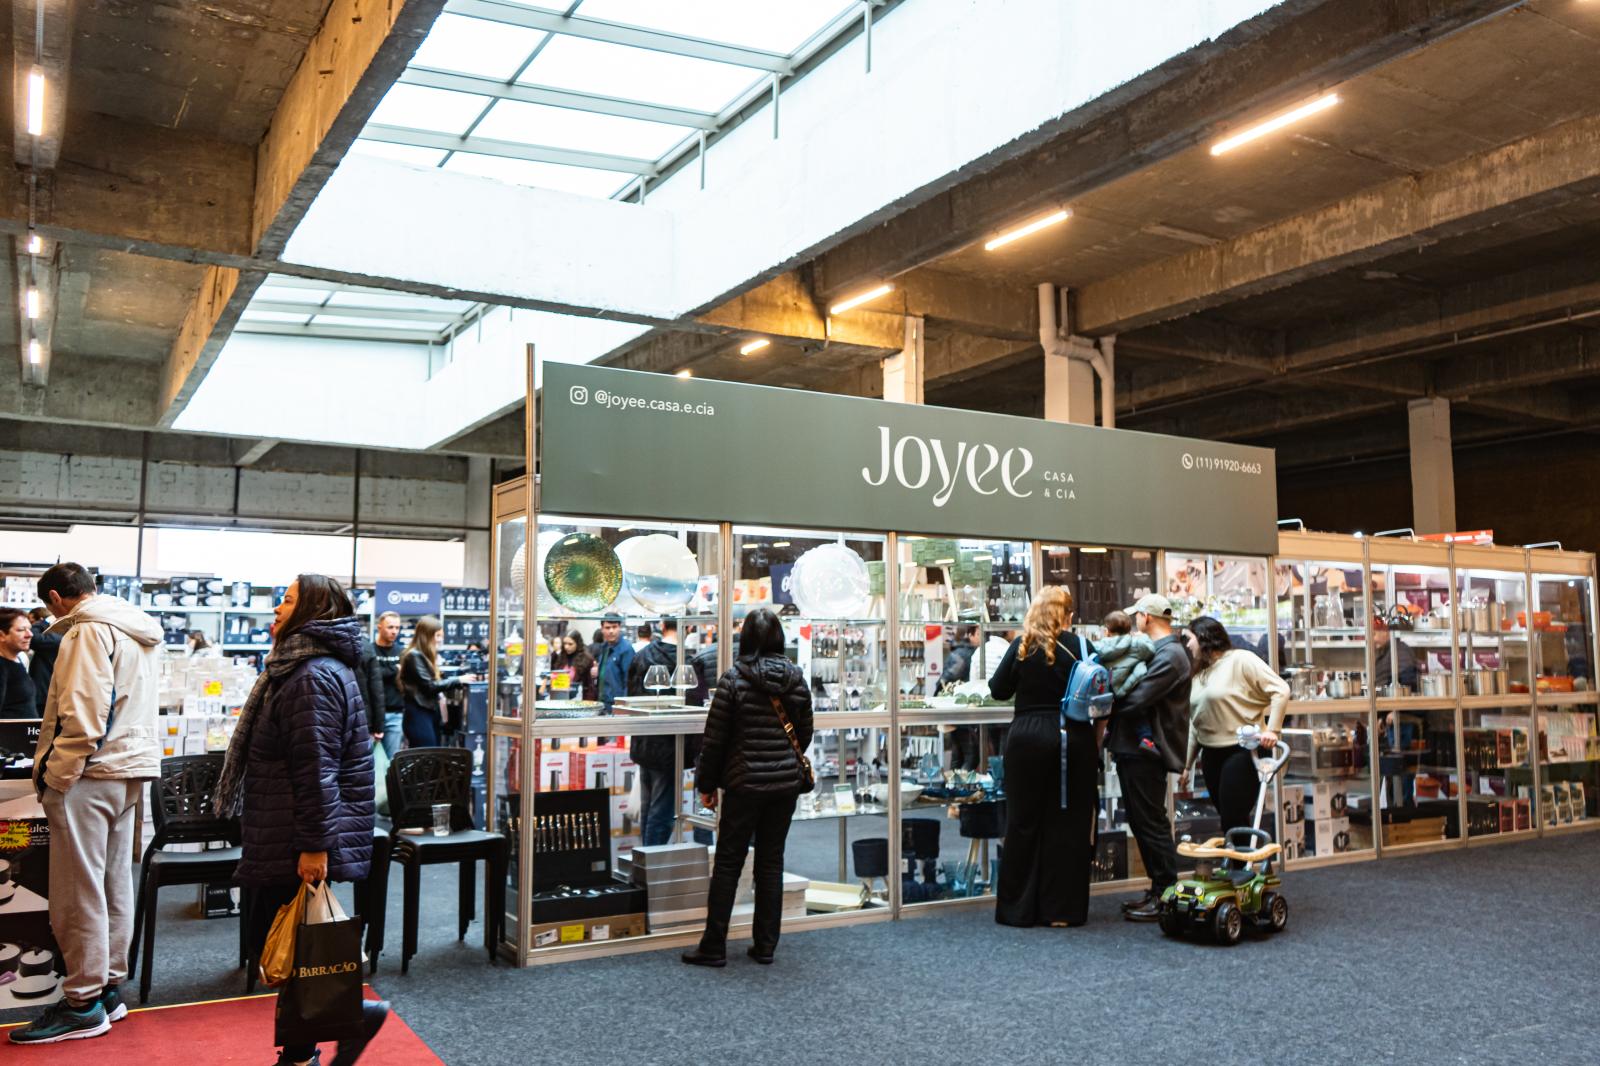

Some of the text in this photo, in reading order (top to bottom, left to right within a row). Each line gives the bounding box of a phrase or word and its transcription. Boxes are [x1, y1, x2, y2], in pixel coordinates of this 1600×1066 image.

[594, 389, 715, 416] @joyee.casa.e.cia
[861, 426, 1034, 508] Joyee
[1043, 471, 1075, 484] CASA
[1043, 488, 1076, 500] & CIA
